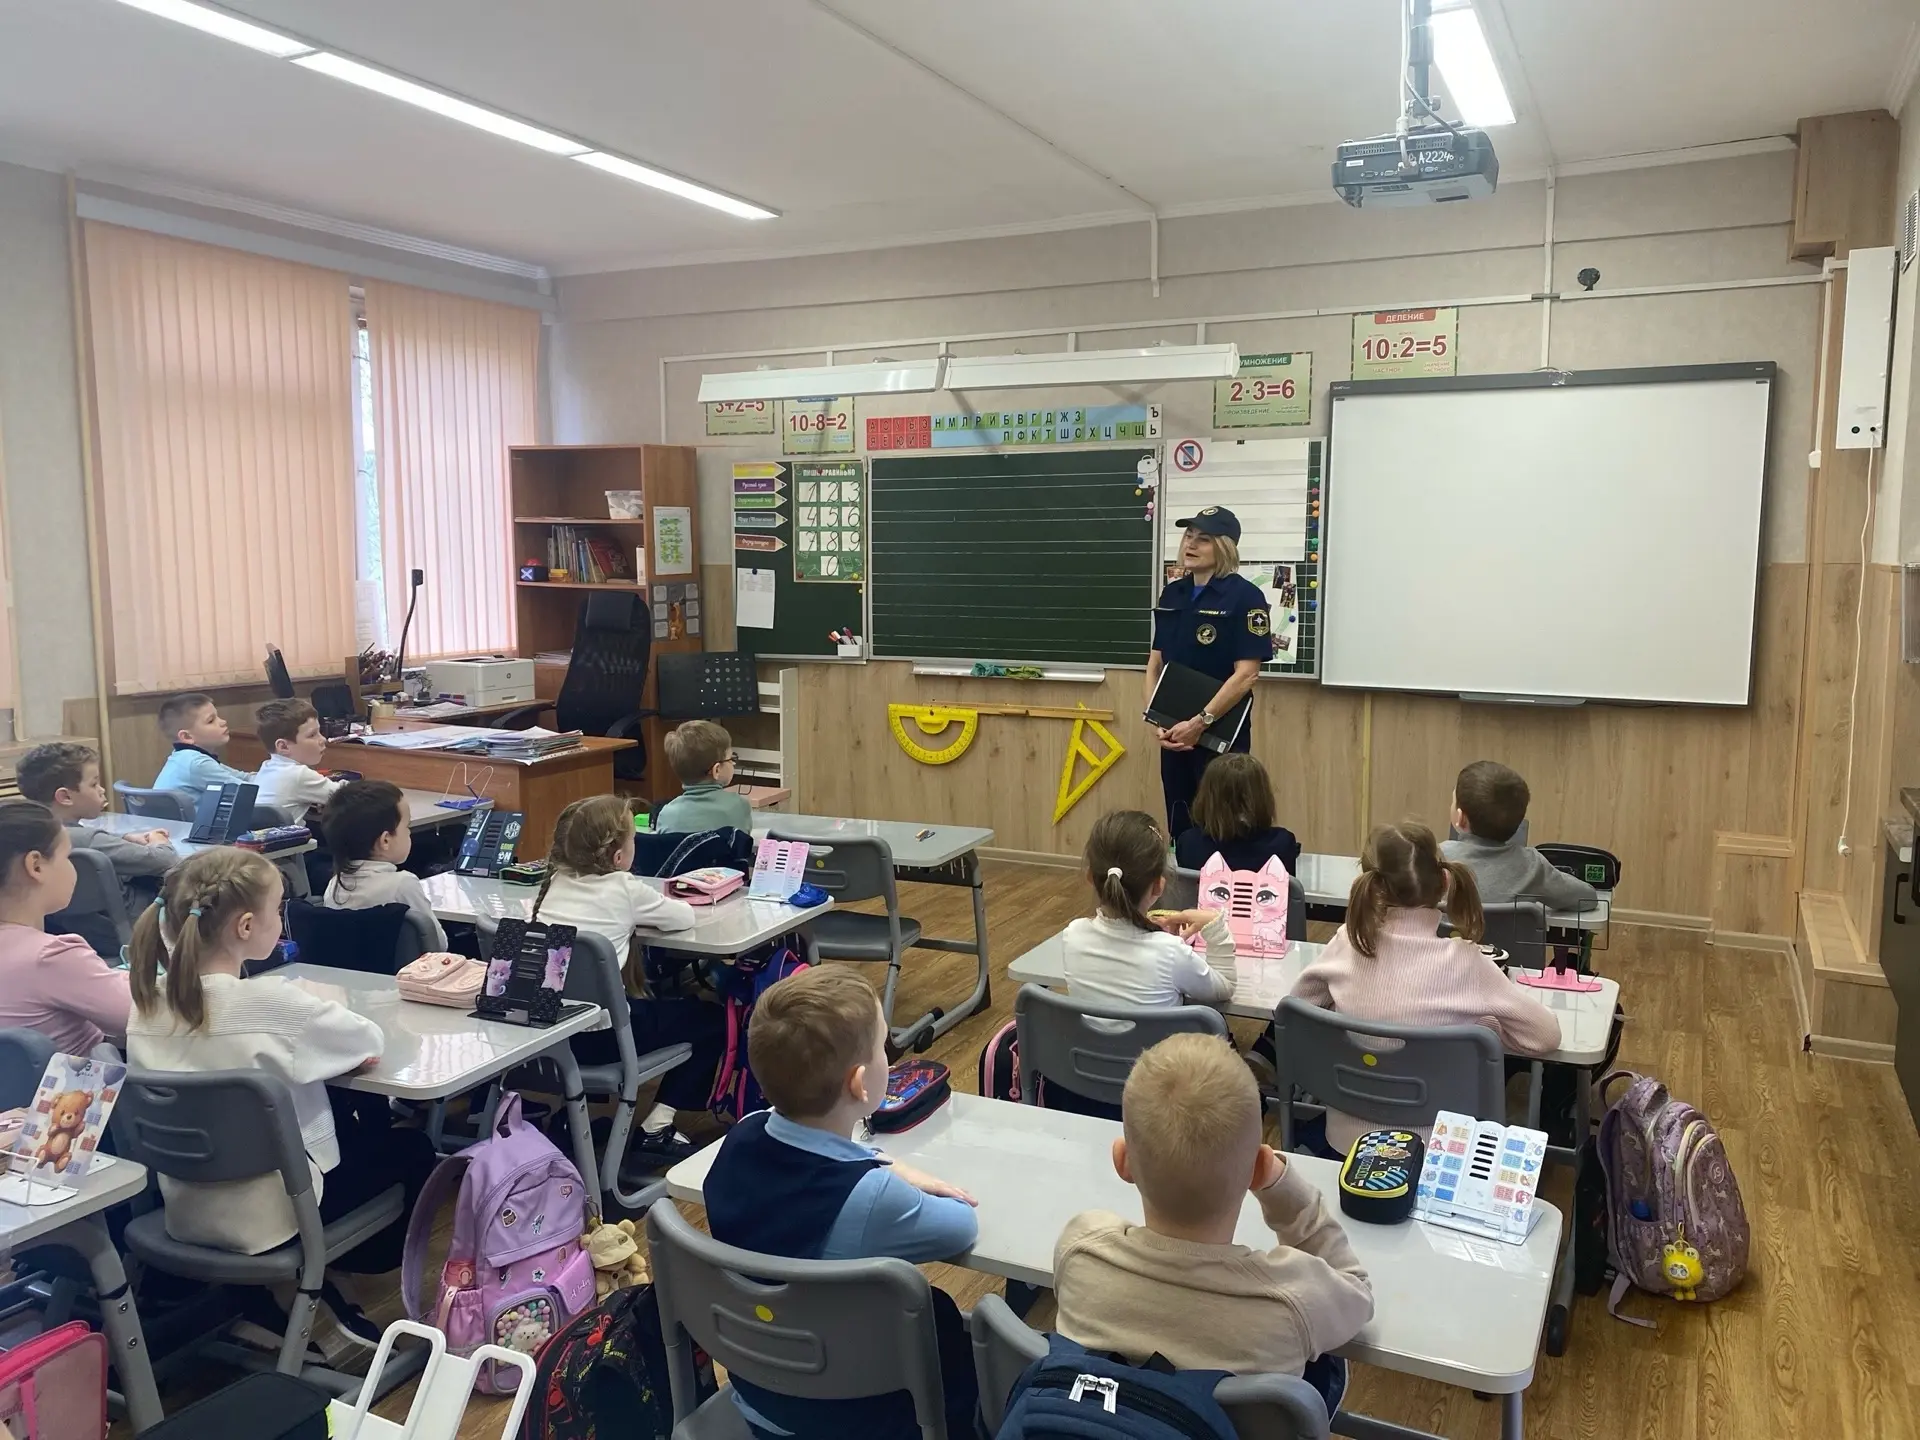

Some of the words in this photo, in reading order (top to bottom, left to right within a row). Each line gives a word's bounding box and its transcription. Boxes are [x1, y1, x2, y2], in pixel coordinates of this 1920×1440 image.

[1385, 312, 1425, 323] ДЕЛЕНИЕ
[1362, 335, 1447, 360] 10:2=5
[1239, 356, 1288, 366] УМНОЖЕНИЕ
[789, 413, 847, 432] 10-8=2
[935, 418, 941, 428] Н
[948, 417, 956, 427] М
[962, 417, 968, 427] Л
[976, 416, 981, 426] Р
[1003, 414, 1009, 424] Б
[1017, 414, 1023, 424] В
[1031, 413, 1036, 423] Г
[1045, 412, 1052, 424] Д
[1060, 411, 1069, 422] Ж
[1075, 411, 1081, 422] З
[1151, 407, 1158, 418] Ъ
[1004, 431, 1009, 441] П
[1017, 430, 1024, 440] Ф
[1031, 430, 1037, 439] К
[1046, 429, 1052, 439] Т
[1060, 428, 1069, 438] Ш
[1075, 427, 1081, 438] С
[1090, 427, 1095, 437] Х
[1104, 426, 1111, 438] Ц
[1119, 425, 1126, 436] Ч
[1135, 425, 1144, 436] Щ
[1150, 425, 1156, 435] Ь
[809, 482, 816, 502] 1
[827, 481, 839, 502] 2
[848, 481, 860, 502] 3
[807, 506, 817, 527] 4
[826, 506, 839, 527] 5
[848, 506, 860, 527] 6
[806, 531, 817, 551] 7
[826, 531, 839, 552] 8
[848, 531, 860, 552] 9
[826, 555, 839, 576] 0
